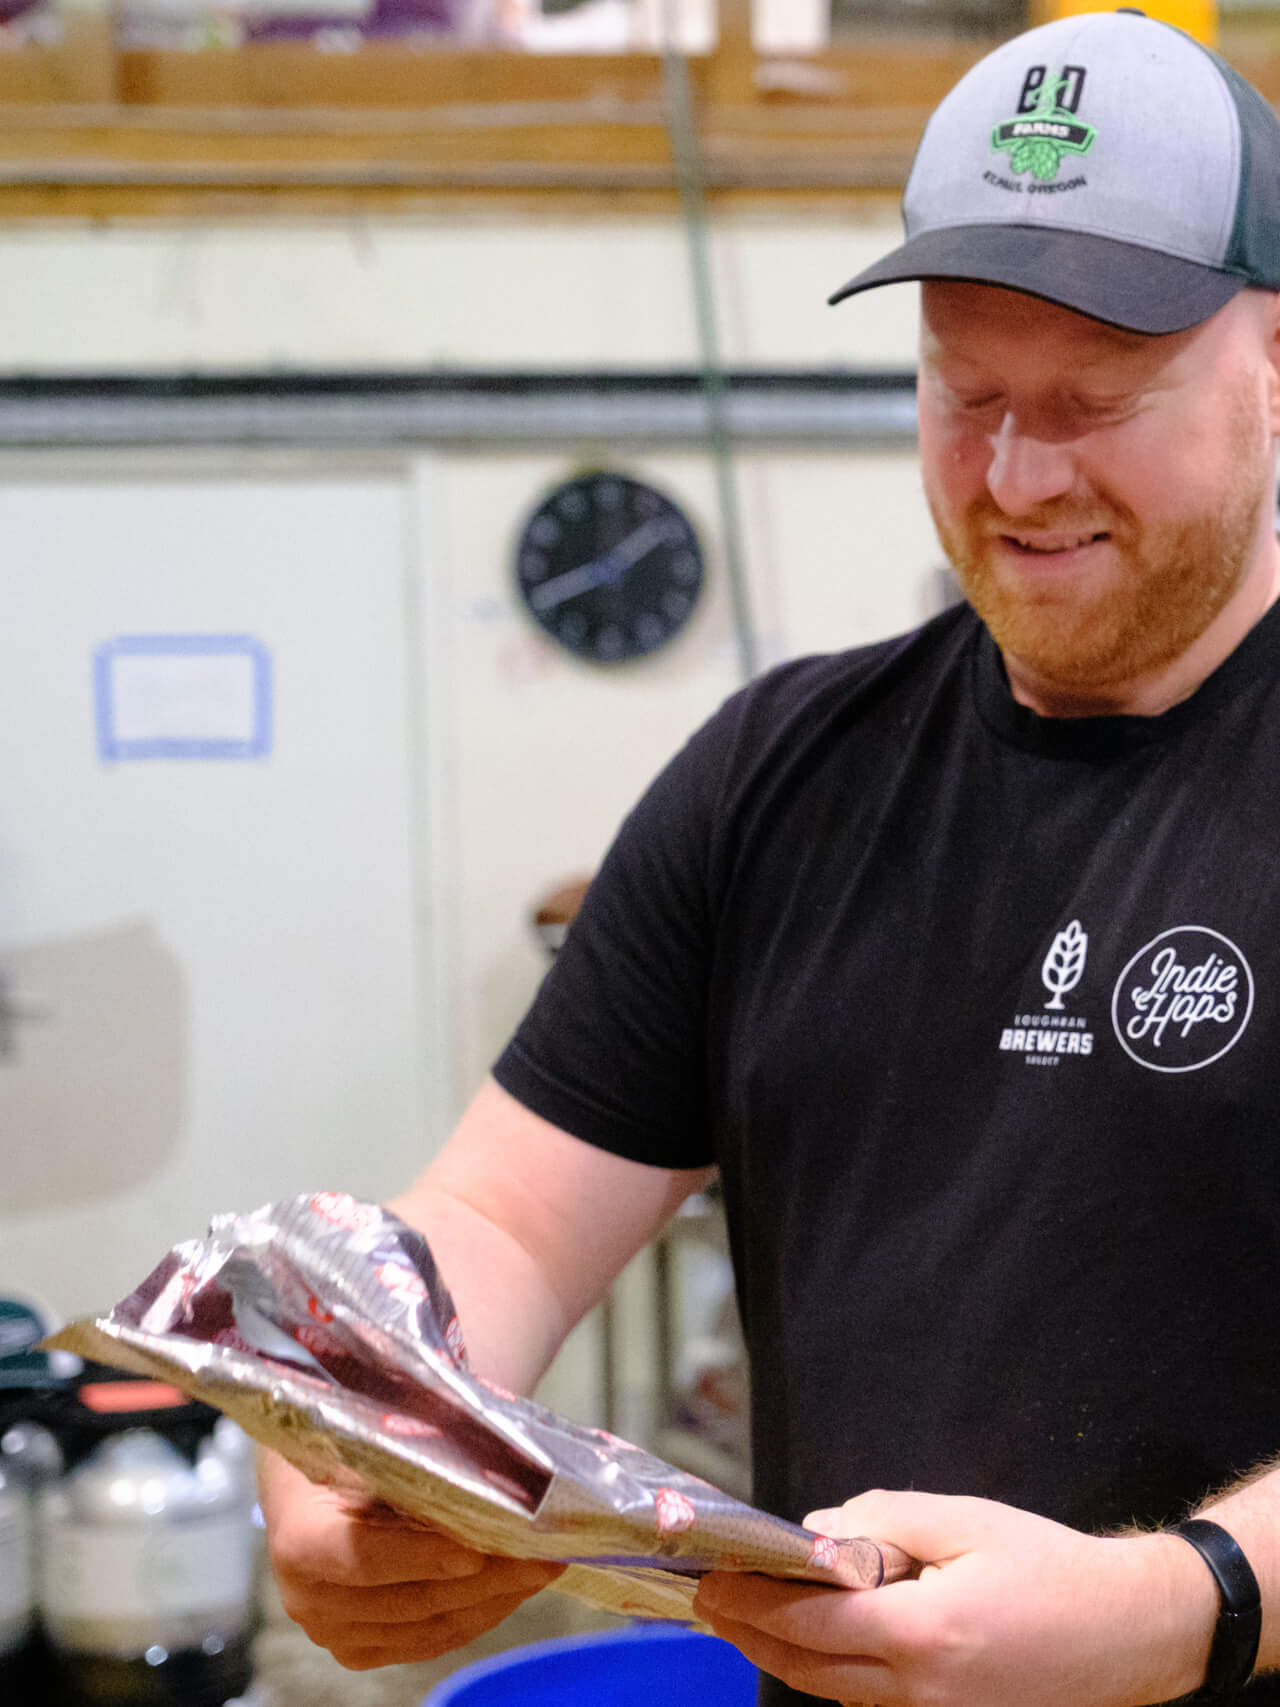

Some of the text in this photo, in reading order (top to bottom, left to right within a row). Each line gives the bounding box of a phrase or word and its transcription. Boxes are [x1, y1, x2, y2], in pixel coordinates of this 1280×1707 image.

[1027, 175, 1088, 195] OREGON
[1131, 947, 1239, 1011] Indie
[1014, 1014, 1088, 1029] LOUGHRAN
[1127, 987, 1238, 1048] Hops
[999, 1028, 1094, 1056] BREWERS
